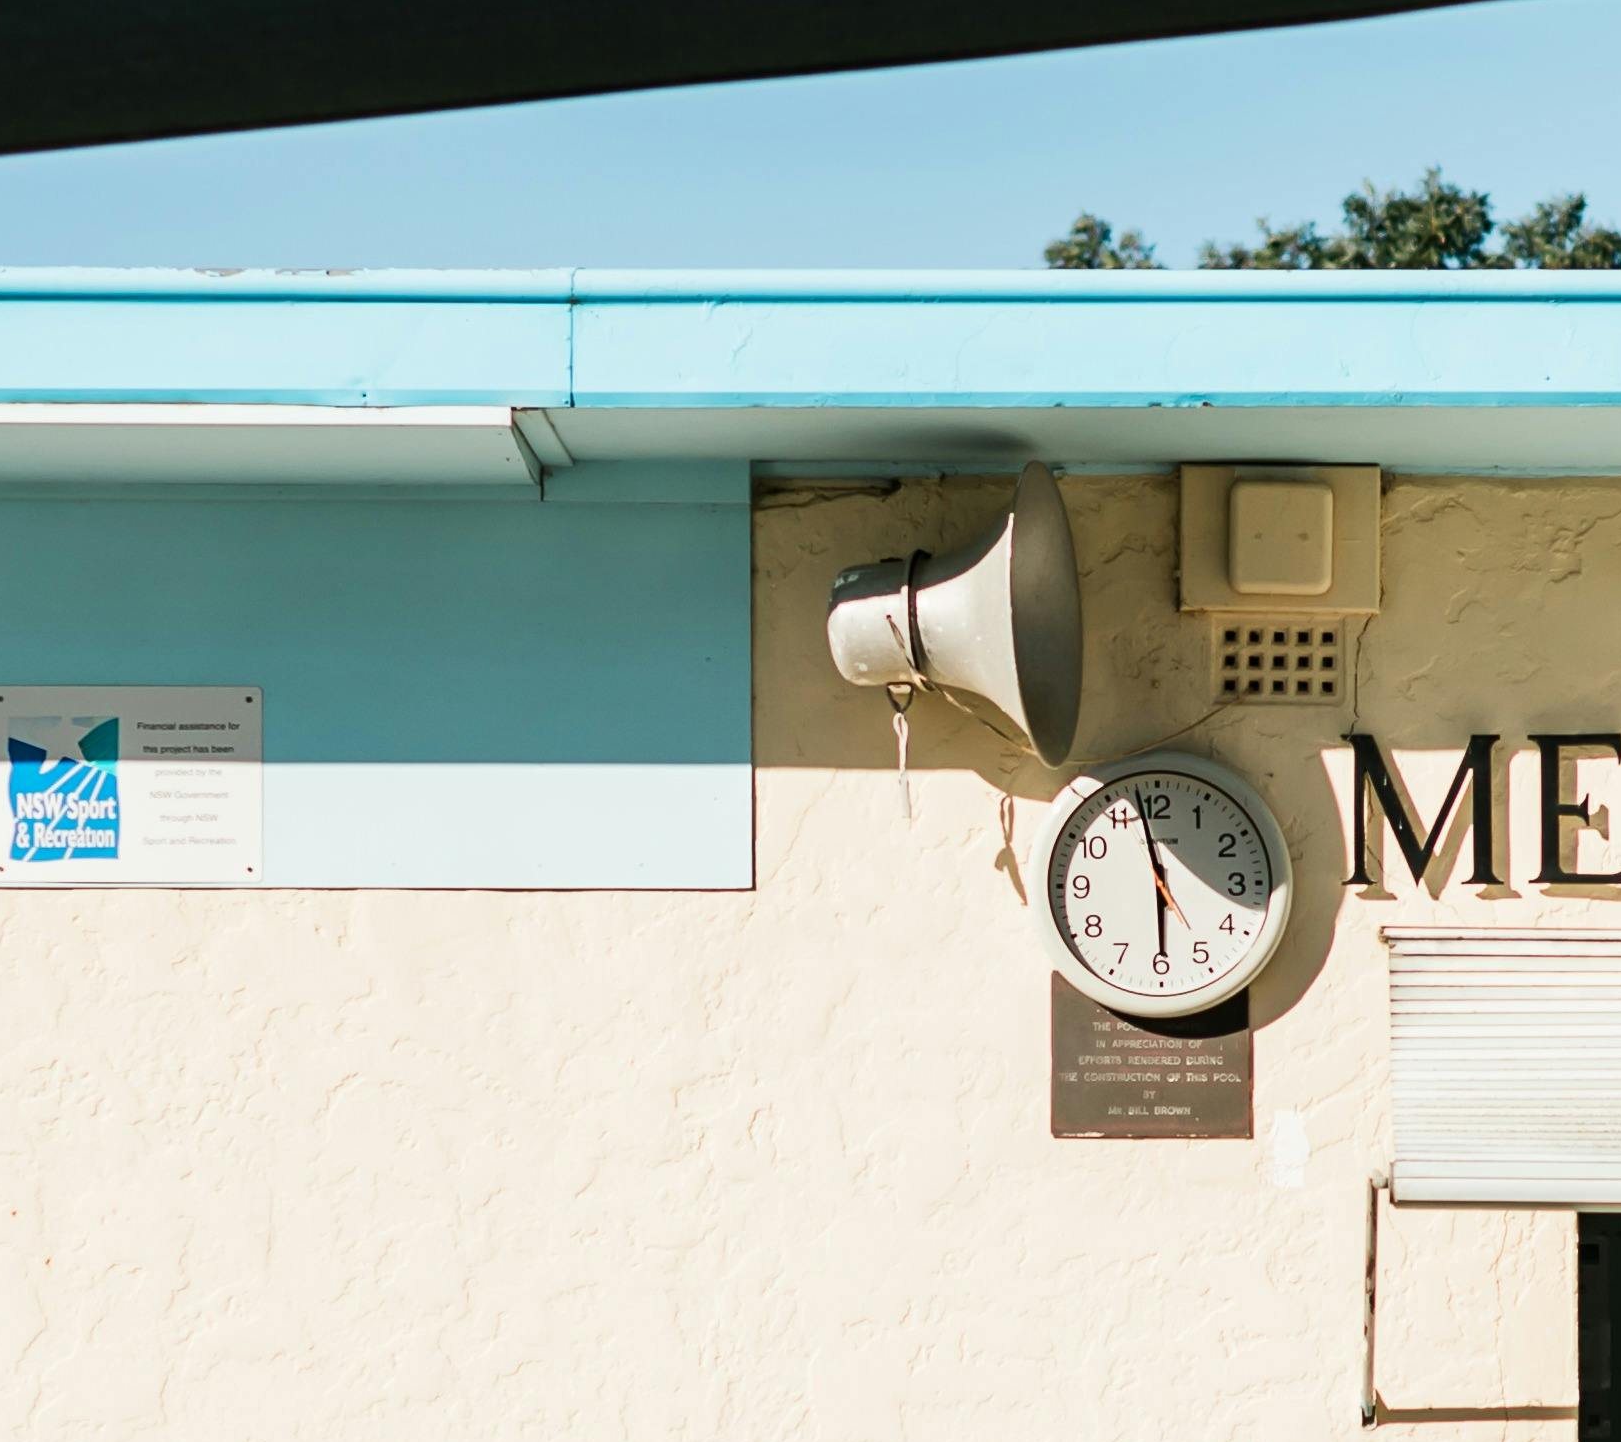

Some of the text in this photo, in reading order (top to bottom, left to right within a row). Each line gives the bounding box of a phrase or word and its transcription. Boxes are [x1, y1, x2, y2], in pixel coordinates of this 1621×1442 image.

[137, 722, 240, 731] Financial assistance for
[143, 745, 234, 756] this project has been
[16, 792, 116, 826] NSW Sport
[1112, 808, 1128, 829] 11
[1144, 795, 1170, 820] 12
[1192, 806, 1202, 829] 1
[16, 822, 115, 848] & Recreation
[1080, 837, 1107, 859] 10
[1218, 835, 1237, 858] 2
[1072, 875, 1090, 899] 9
[1228, 873, 1246, 897] 3
[1085, 915, 1102, 938] 8
[1219, 913, 1235, 935] 4
[1114, 943, 1129, 964] 7
[1192, 941, 1209, 964] 5
[1152, 953, 1170, 975] 6
[1093, 1022, 1111, 1032] THE
[1116, 1022, 1144, 1032] POO
[1096, 1040, 1203, 1049] IN APPRECIATION OF
[1078, 1057, 1224, 1065] EFFORTS RENDERED DURING
[1059, 1073, 1242, 1082] THE CONSTRUCTION OF THIS POOL
[1143, 1091, 1156, 1099] BY
[1128, 1107, 1192, 1116] BILL BROWN
